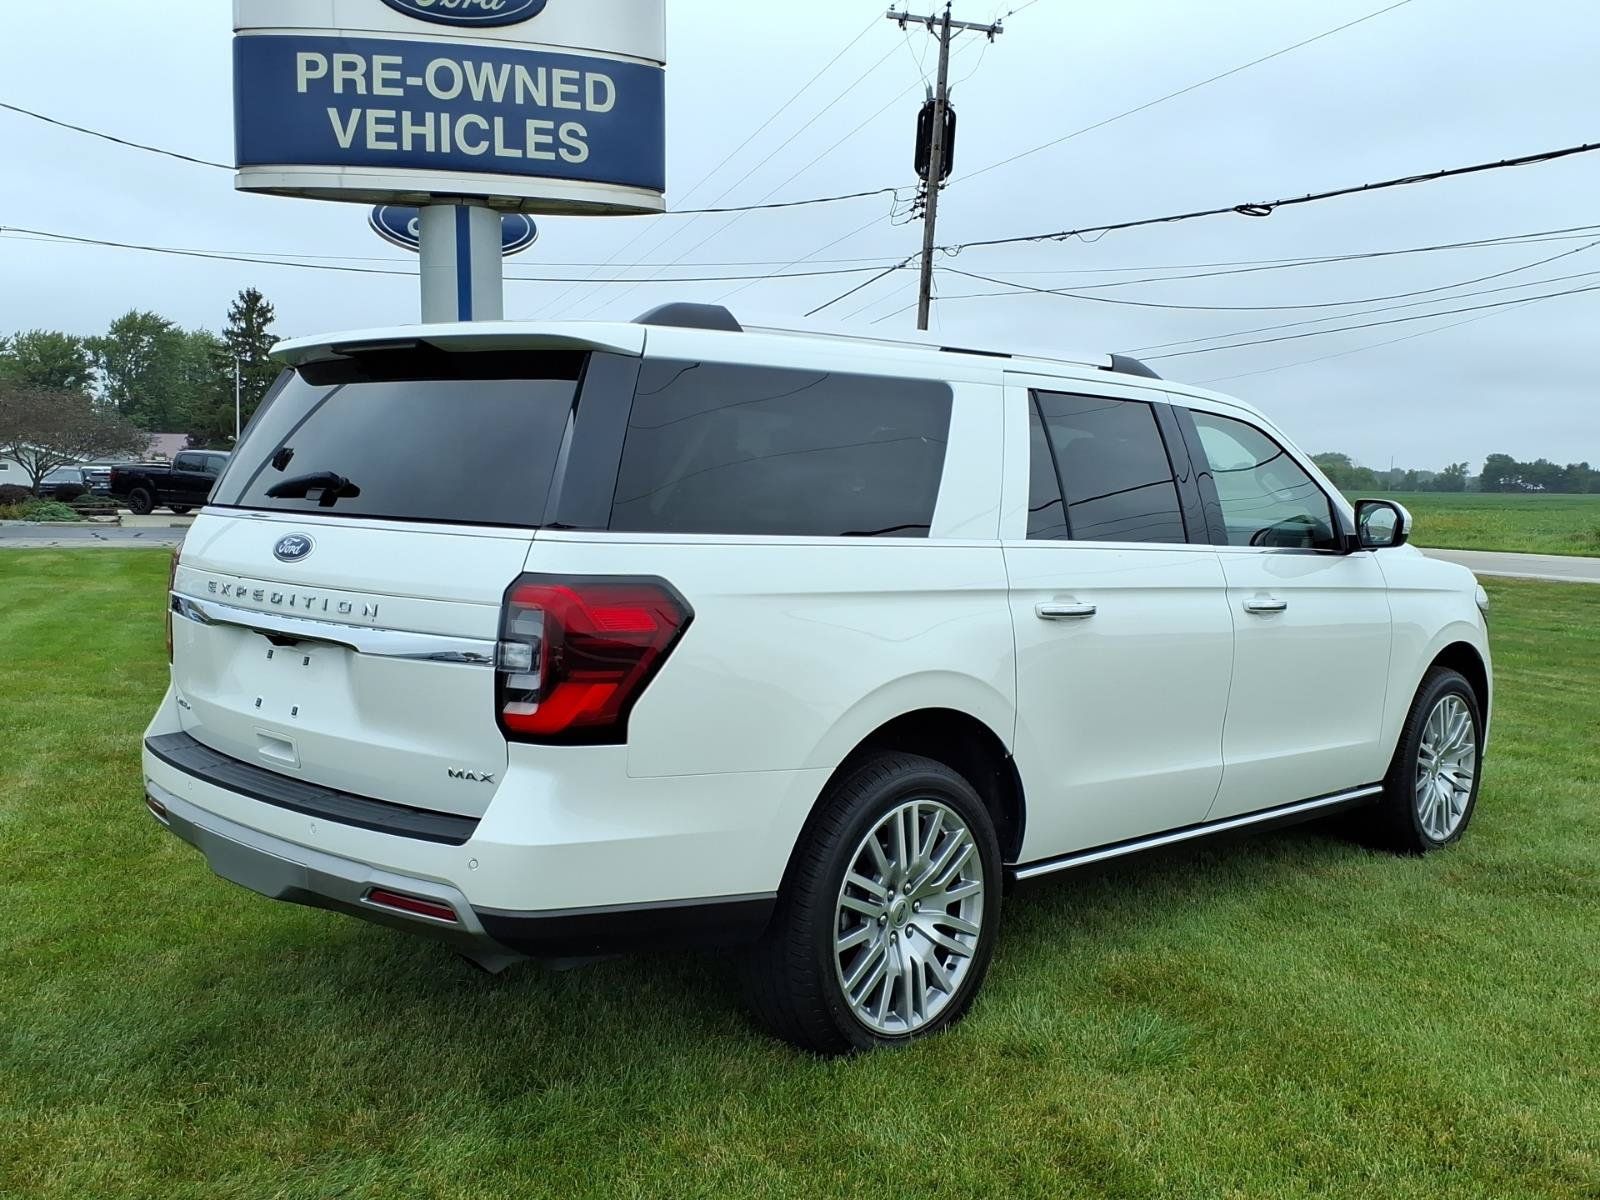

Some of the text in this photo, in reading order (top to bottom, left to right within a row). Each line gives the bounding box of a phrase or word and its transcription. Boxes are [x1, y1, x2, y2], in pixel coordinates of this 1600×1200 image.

[296, 52, 616, 113] PRE-OWNED
[327, 107, 590, 163] VEHICLES
[278, 537, 305, 555] Ford
[208, 580, 379, 617] EXPEDITION
[448, 767, 495, 785] MAX
